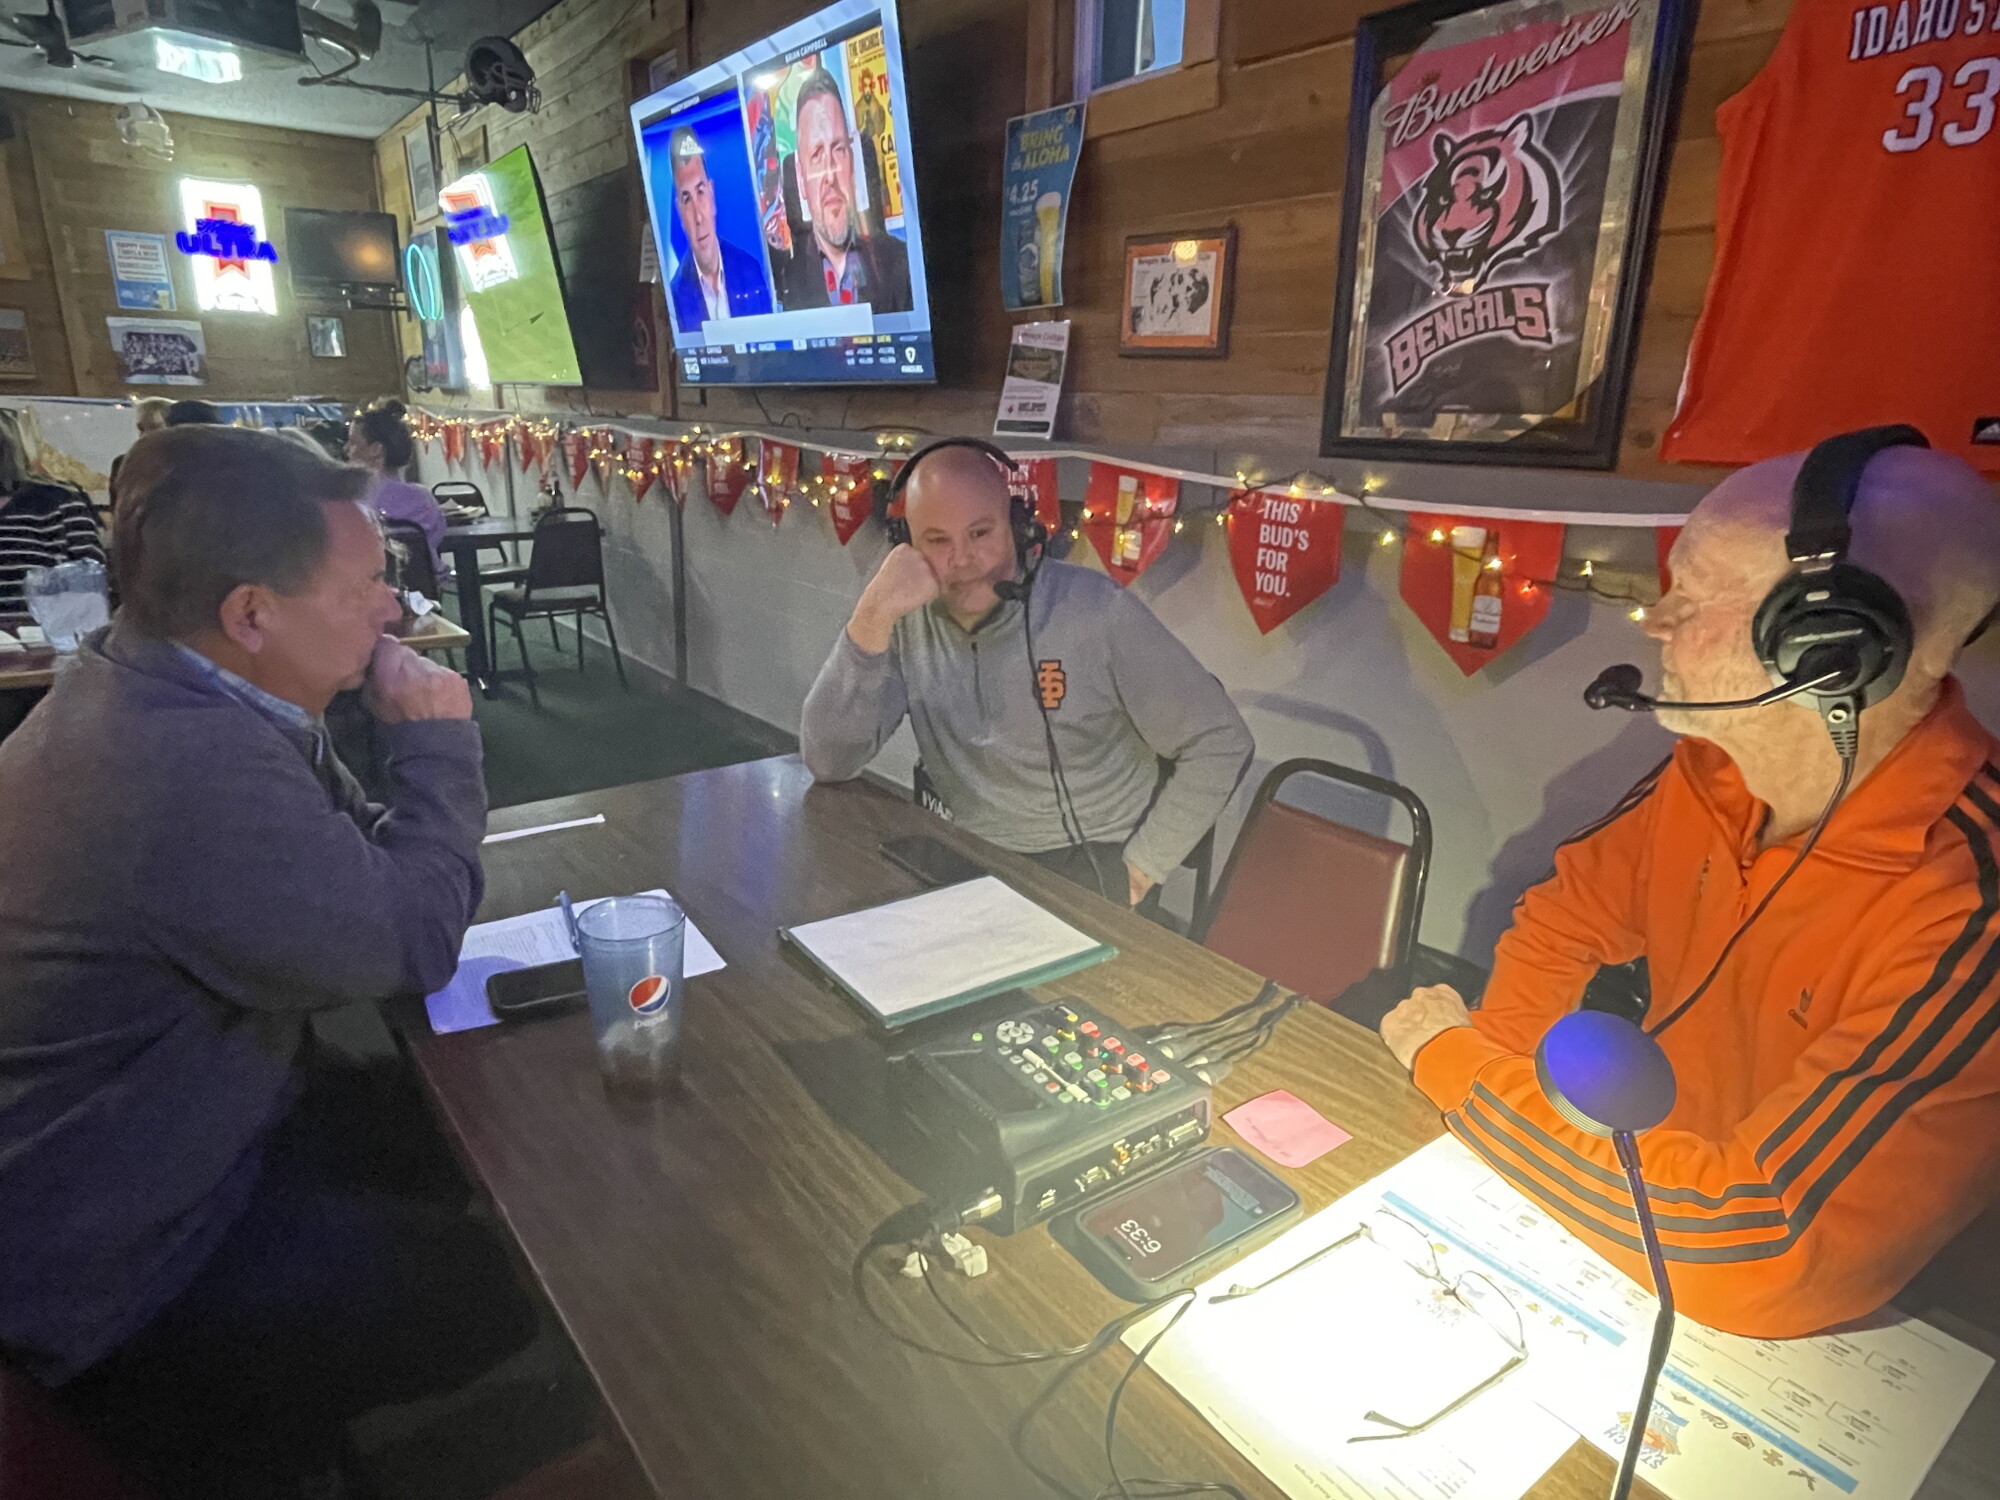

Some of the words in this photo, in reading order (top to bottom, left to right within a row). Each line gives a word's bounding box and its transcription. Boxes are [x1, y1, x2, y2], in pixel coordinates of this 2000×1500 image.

[1849, 0, 1960, 60] IDAHO
[1382, 0, 1641, 147] Budweiser
[1882, 57, 2000, 152] 33
[1021, 127, 1064, 152] BRING
[176, 231, 278, 263] ULTRA
[1384, 283, 1552, 395] BENGALS
[1263, 499, 1300, 524] THIS
[1259, 524, 1309, 551] BUD'S
[1257, 548, 1288, 573] FOR
[1255, 571, 1291, 598] YOU.
[634, 1011, 669, 1030] pepsi
[1120, 1219, 1162, 1254] 6:33
